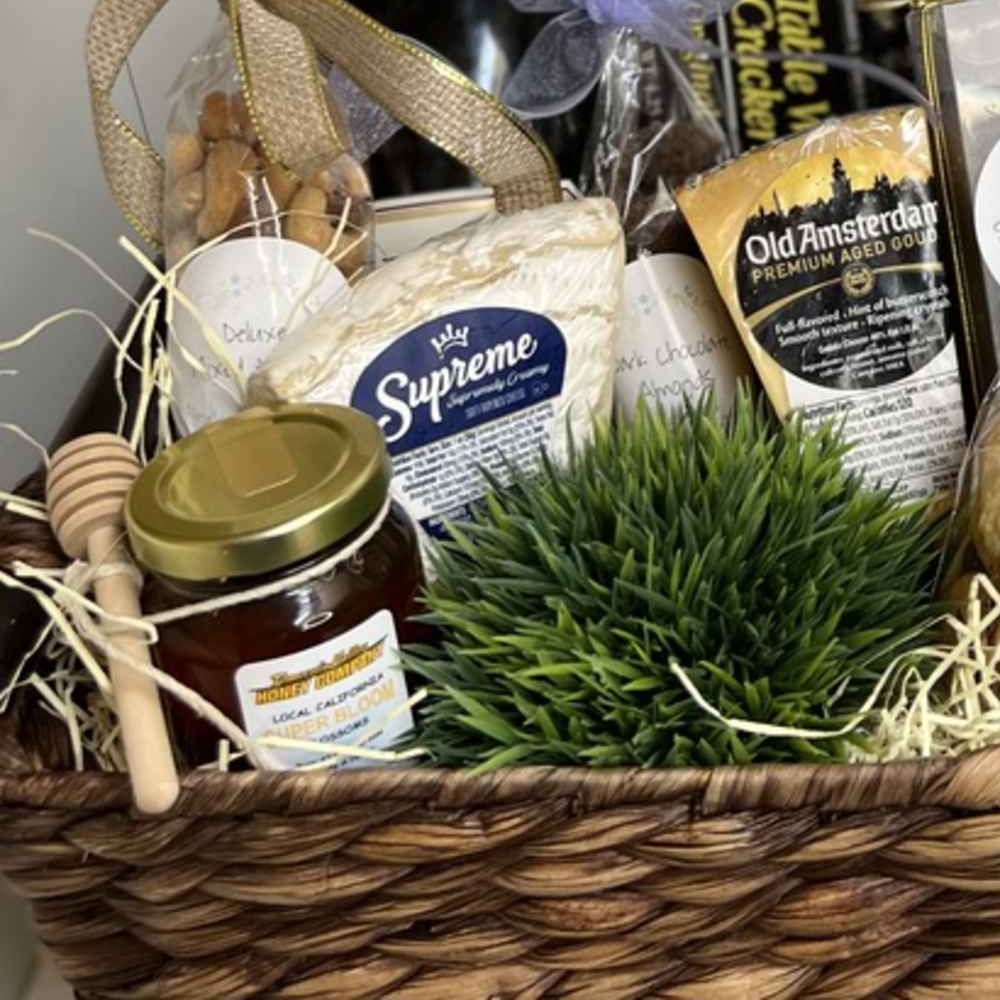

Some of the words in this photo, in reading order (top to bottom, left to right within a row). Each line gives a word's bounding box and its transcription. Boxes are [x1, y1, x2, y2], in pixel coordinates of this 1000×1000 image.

[745, 230, 796, 264] Old
[751, 252, 835, 285] PREMIUM
[840, 240, 887, 264] AGED
[873, 298, 885, 313] of
[222, 319, 287, 344] Deluxe
[376, 331, 538, 443] Supreme
[254, 681, 310, 705] HONEY
[272, 707, 312, 724] LOCAL
[316, 672, 384, 711] CALIFORNIA
